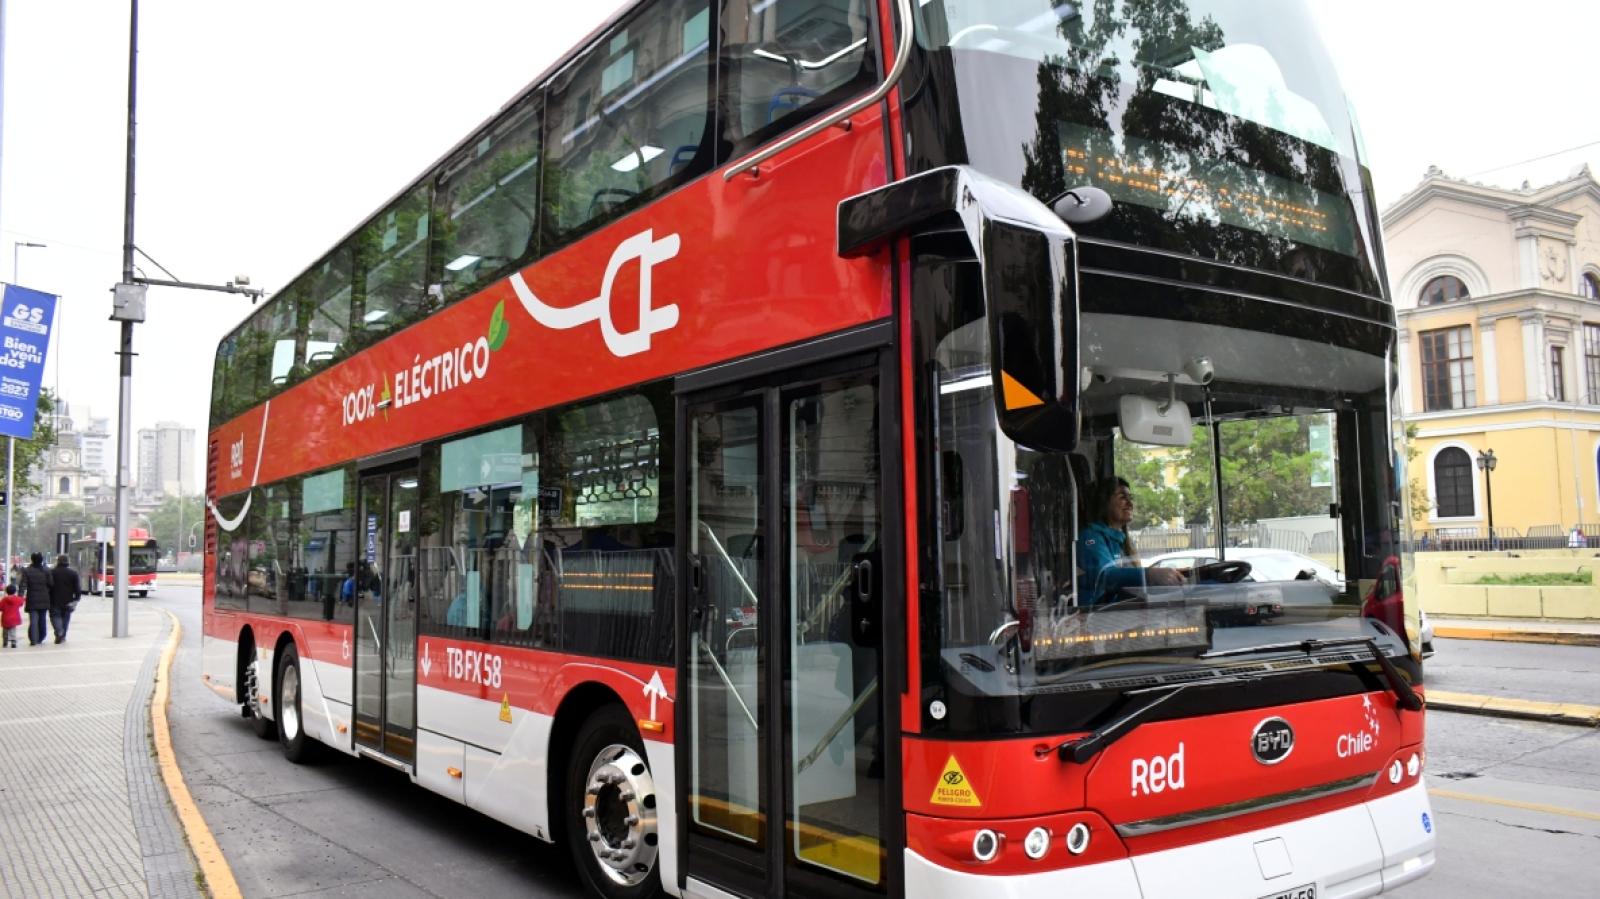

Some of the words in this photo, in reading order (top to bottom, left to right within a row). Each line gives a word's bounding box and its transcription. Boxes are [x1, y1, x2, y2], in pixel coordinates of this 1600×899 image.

[4, 336, 37, 354] Bien
[342, 383, 375, 426] 100%
[394, 335, 490, 409] ELÉCTRICO
[1257, 728, 1292, 753] BYD
[1336, 730, 1373, 758] Chile
[1131, 741, 1185, 797] Red
